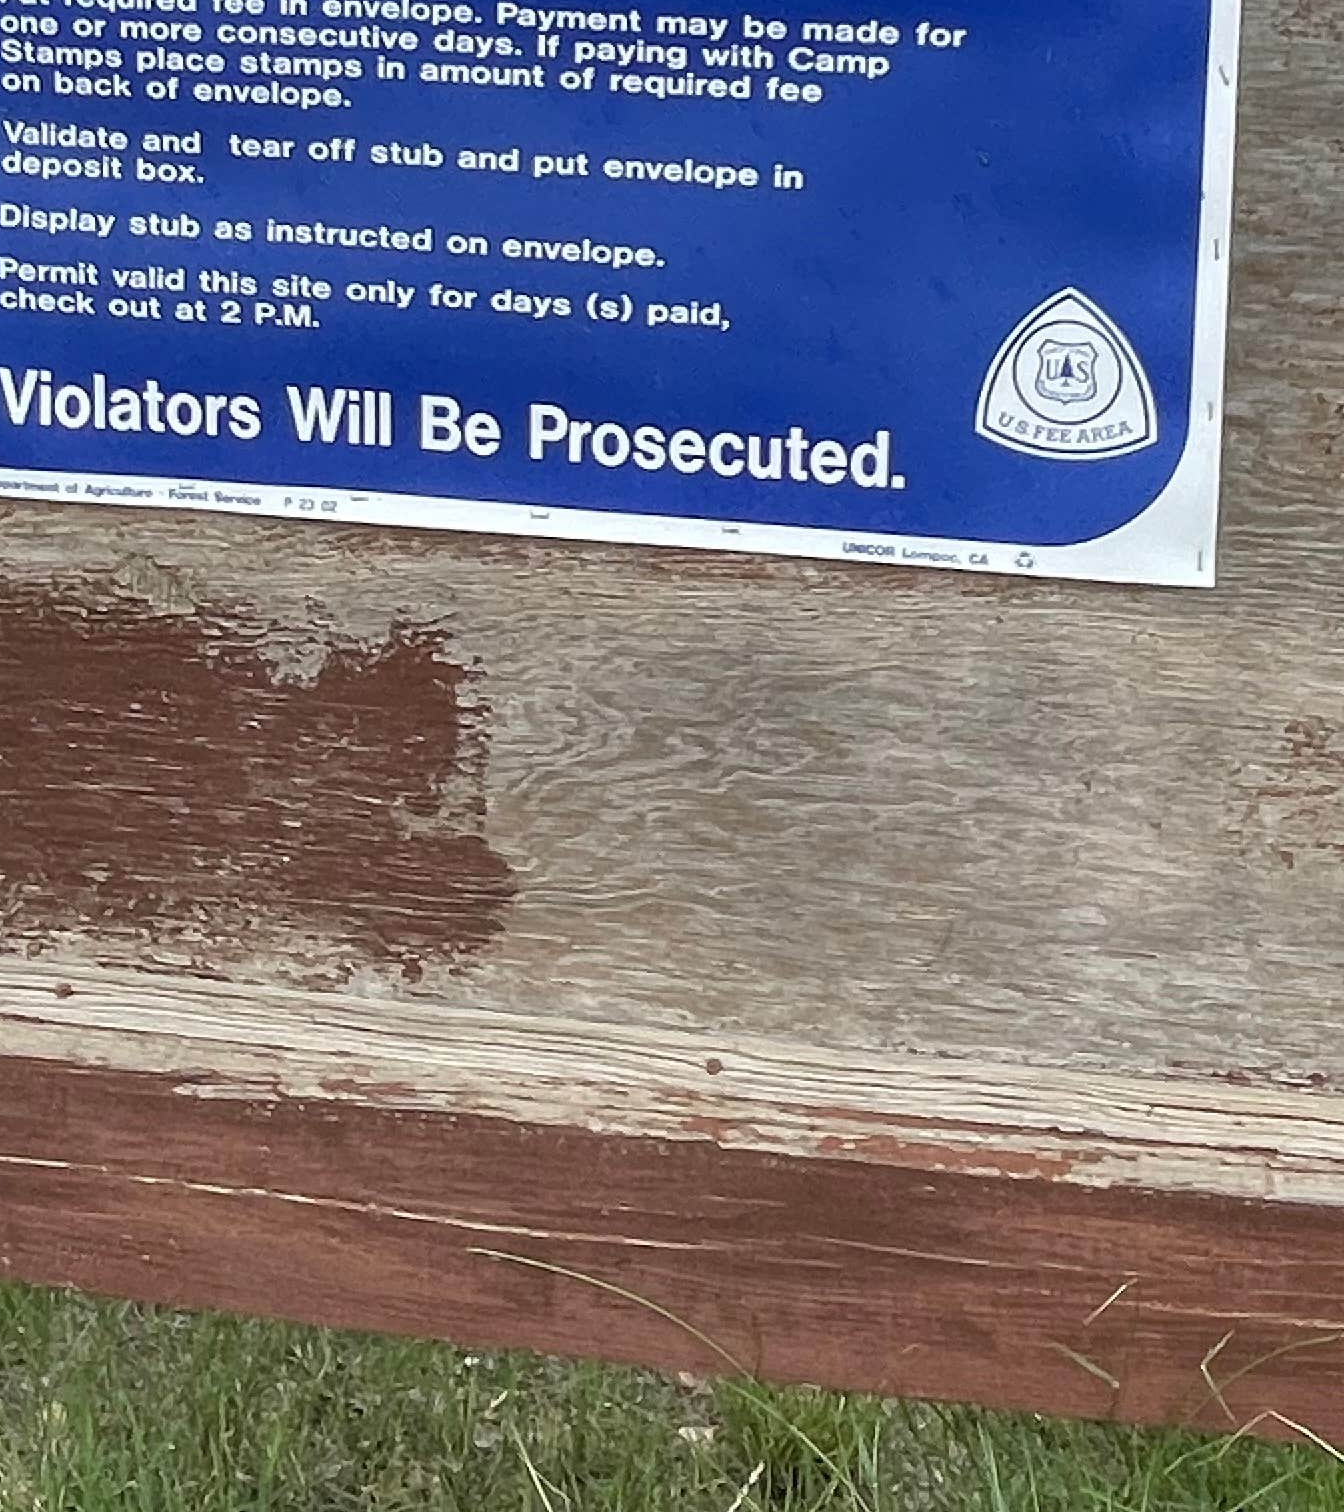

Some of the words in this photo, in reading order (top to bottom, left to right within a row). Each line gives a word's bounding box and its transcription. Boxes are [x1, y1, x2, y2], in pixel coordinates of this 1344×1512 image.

[0, 15, 60, 36] one
[72, 18, 107, 37] or
[120, 19, 203, 42] more
[217, 23, 418, 51] consecutive
[434, 29, 523, 57] days.
[537, 34, 560, 58] If
[574, 39, 687, 70] paying
[702, 44, 774, 69] with
[787, 47, 891, 79] Camp
[496, 1, 643, 38] Payment
[656, 14, 728, 42] may
[743, 14, 788, 41] be
[802, 20, 901, 46] made
[916, 21, 968, 49] for
[0, 39, 122, 69] Stamps
[136, 47, 226, 73] place
[240, 52, 362, 80] stamps
[377, 55, 406, 80] in
[420, 61, 544, 89] amount
[559, 66, 594, 92] of
[609, 71, 752, 100] required
[766, 77, 824, 104] fee
[2, 72, 42, 93] on
[55, 73, 131, 98] back
[146, 77, 180, 100] of
[193, 81, 352, 110] envelope.
[2, 119, 128, 151] Validate
[142, 129, 203, 154] and
[229, 134, 296, 159] tear
[309, 138, 356, 162] off
[371, 142, 443, 168] stub
[457, 148, 521, 172] and
[533, 153, 589, 178] put
[603, 158, 759, 189] envelope
[773, 164, 804, 189] in
[2, 151, 122, 180] deposit
[137, 158, 205, 184] box.
[129, 212, 201, 238] stub
[214, 221, 253, 240] as
[266, 219, 431, 252] instructed
[446, 233, 488, 256] on
[502, 237, 666, 269] envelope.
[0, 288, 96, 315] check
[108, 298, 162, 320] out
[174, 302, 208, 323] at
[220, 300, 242, 325] 2
[255, 303, 321, 328] P.M.
[113, 266, 185, 292] valid
[199, 270, 258, 295] this
[272, 275, 332, 300] site
[346, 279, 415, 309] only
[428, 283, 478, 309] for
[491, 289, 571, 319] days
[585, 292, 633, 322] (s)
[646, 300, 731, 332] paid,
[286, 385, 393, 448] Will
[420, 393, 501, 457] Be
[530, 402, 906, 490] Prosecuted.
[1033, 424, 1072, 443] FEE
[1076, 420, 1133, 443] AREA
